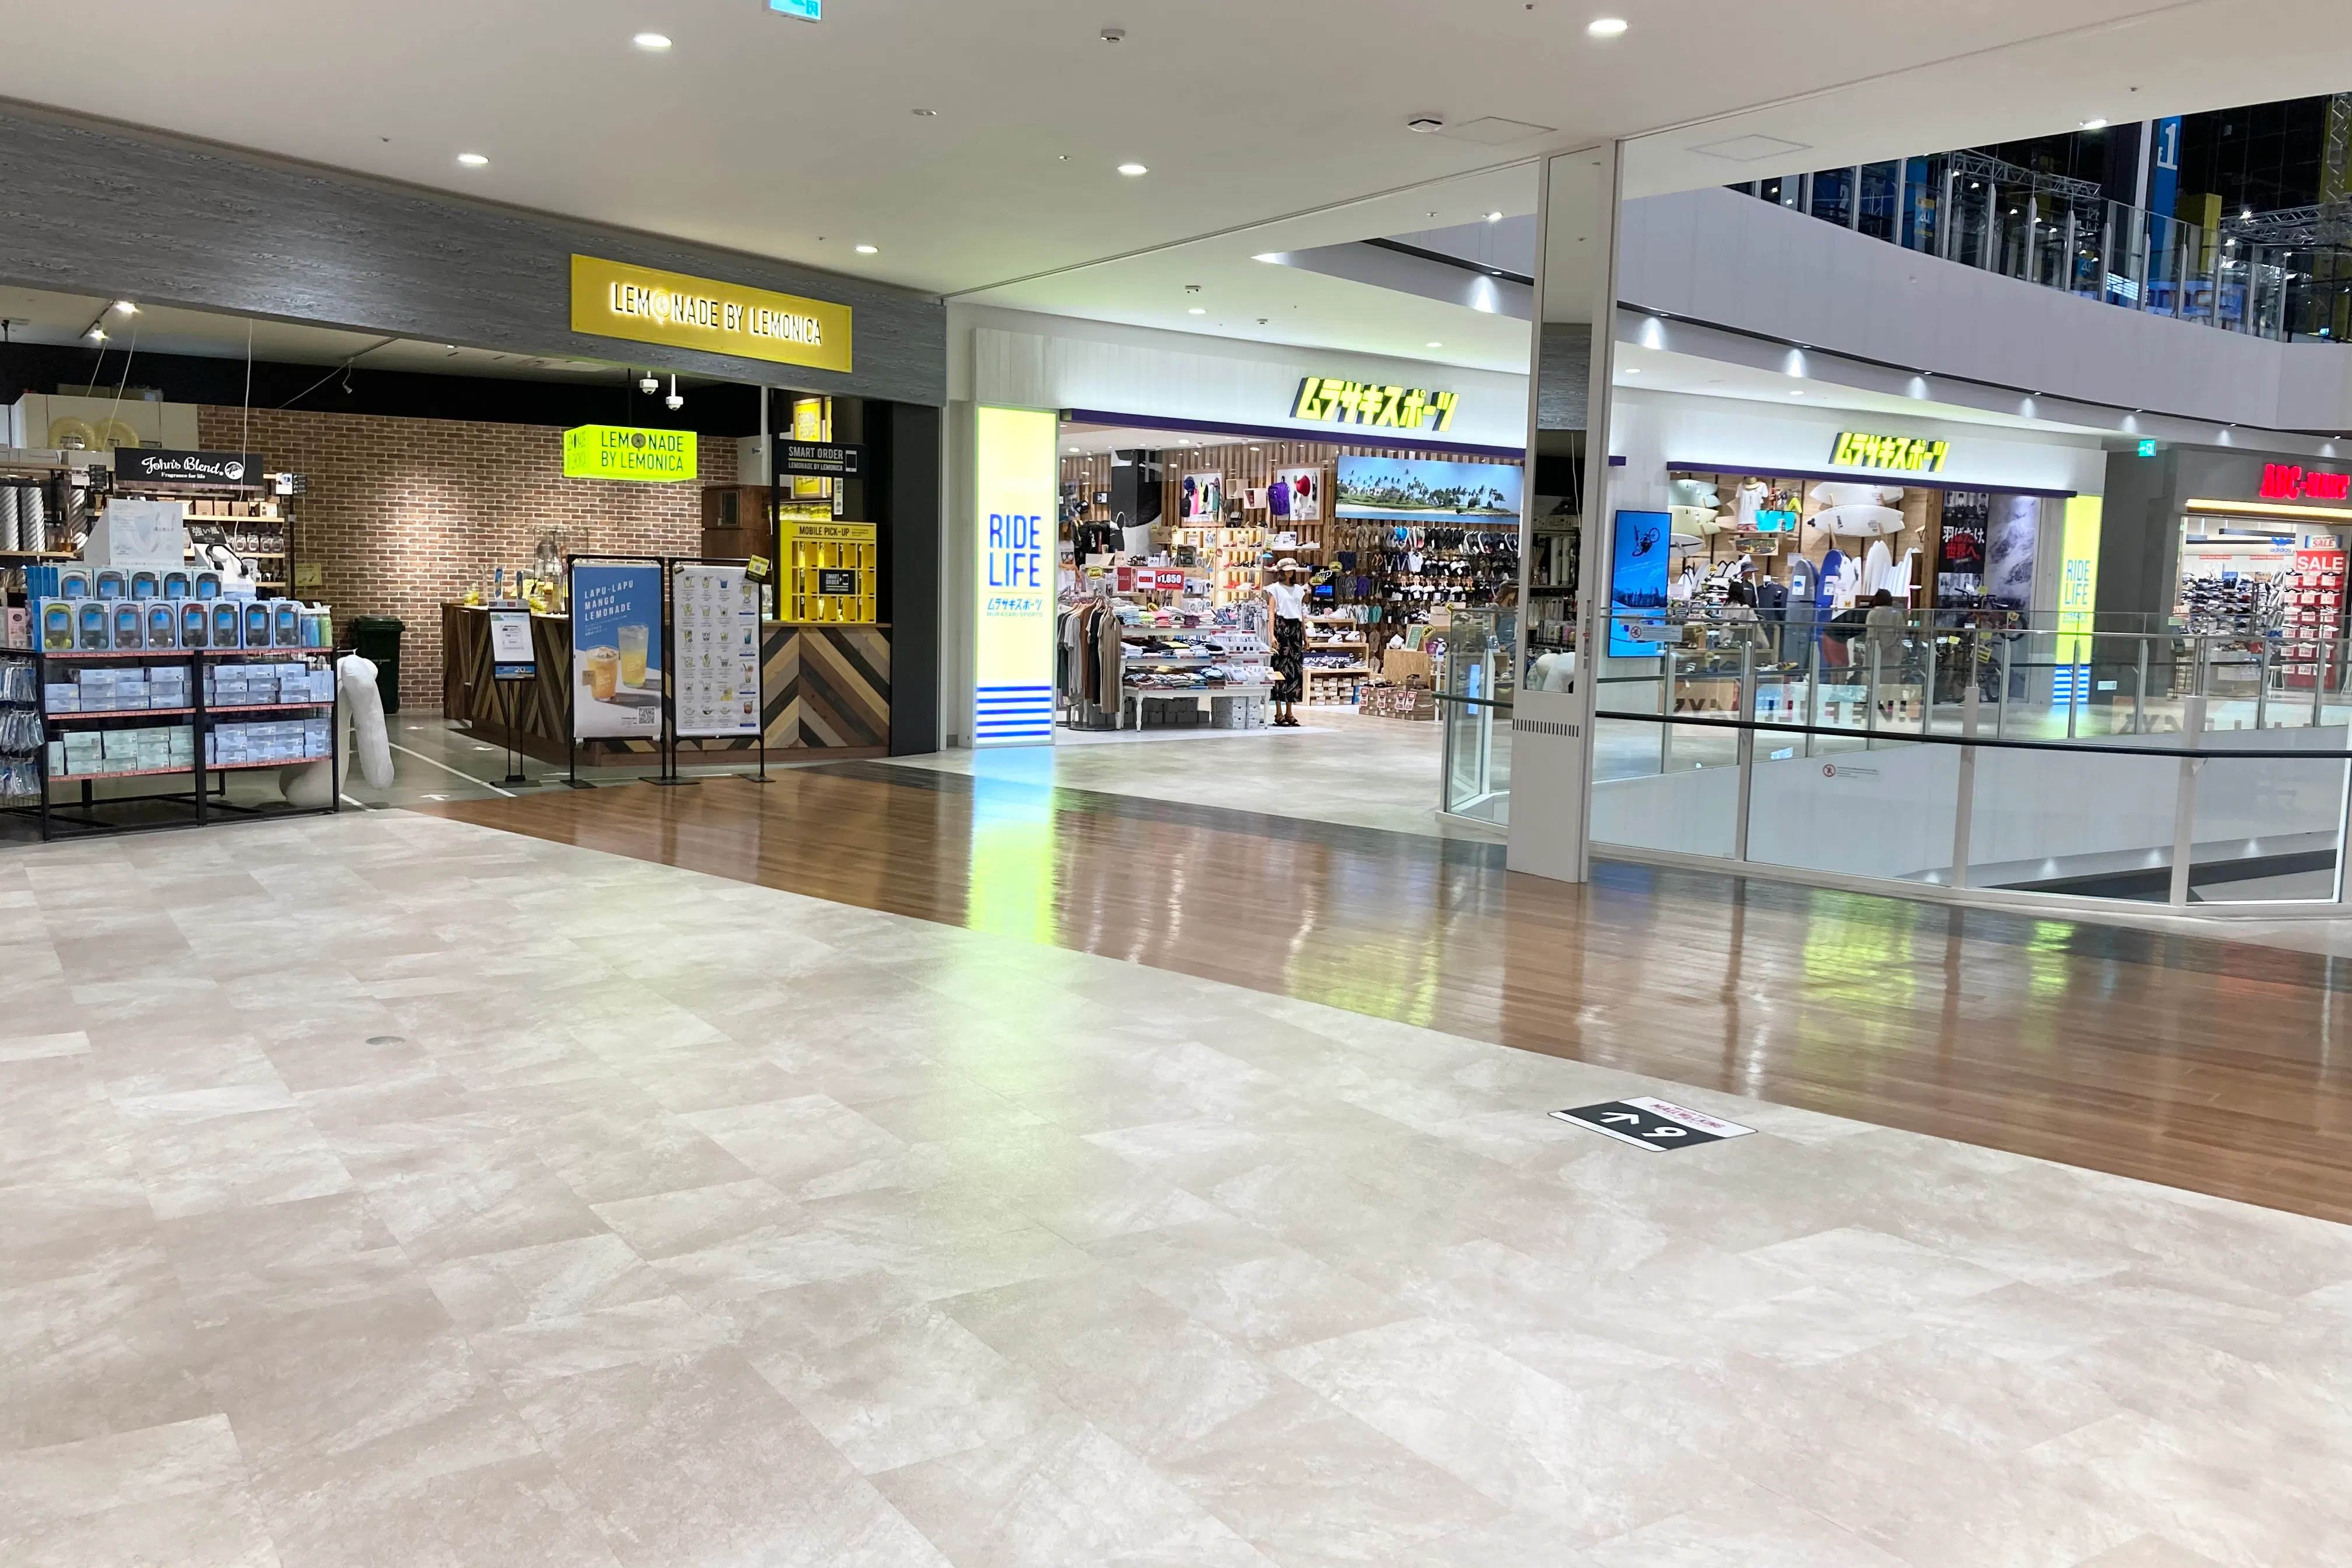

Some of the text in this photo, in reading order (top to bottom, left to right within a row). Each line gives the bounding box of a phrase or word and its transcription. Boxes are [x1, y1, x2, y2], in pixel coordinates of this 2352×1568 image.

[725, 303, 744, 332] BY
[750, 307, 822, 345] LEMONICA
[1293, 377, 1460, 432] ムラサキスポーツ
[602, 451, 684, 472] BY LEMONICA
[789, 446, 844, 460] SMART ORDER
[1832, 432, 1950, 473] ムラサキスポーツ
[141, 456, 181, 474] John's
[789, 461, 813, 470] LEMONADE
[2260, 464, 2350, 500] ABC-MART
[799, 526, 822, 536] MOBILE
[824, 527, 849, 536] PICK-UP
[989, 513, 1041, 550] RIDE
[989, 552, 1041, 587] LIFE
[2066, 559, 2091, 581] RIDE
[2297, 556, 2344, 570] SALE
[584, 579, 634, 599] LAPU-LAPU
[2065, 583, 2089, 604] LIFE
[584, 596, 615, 610] MANGO
[585, 603, 631, 621] LEMONADE
[987, 598, 1043, 611] ムラサキスポーツ
[1641, 1126, 1688, 1137] 9
